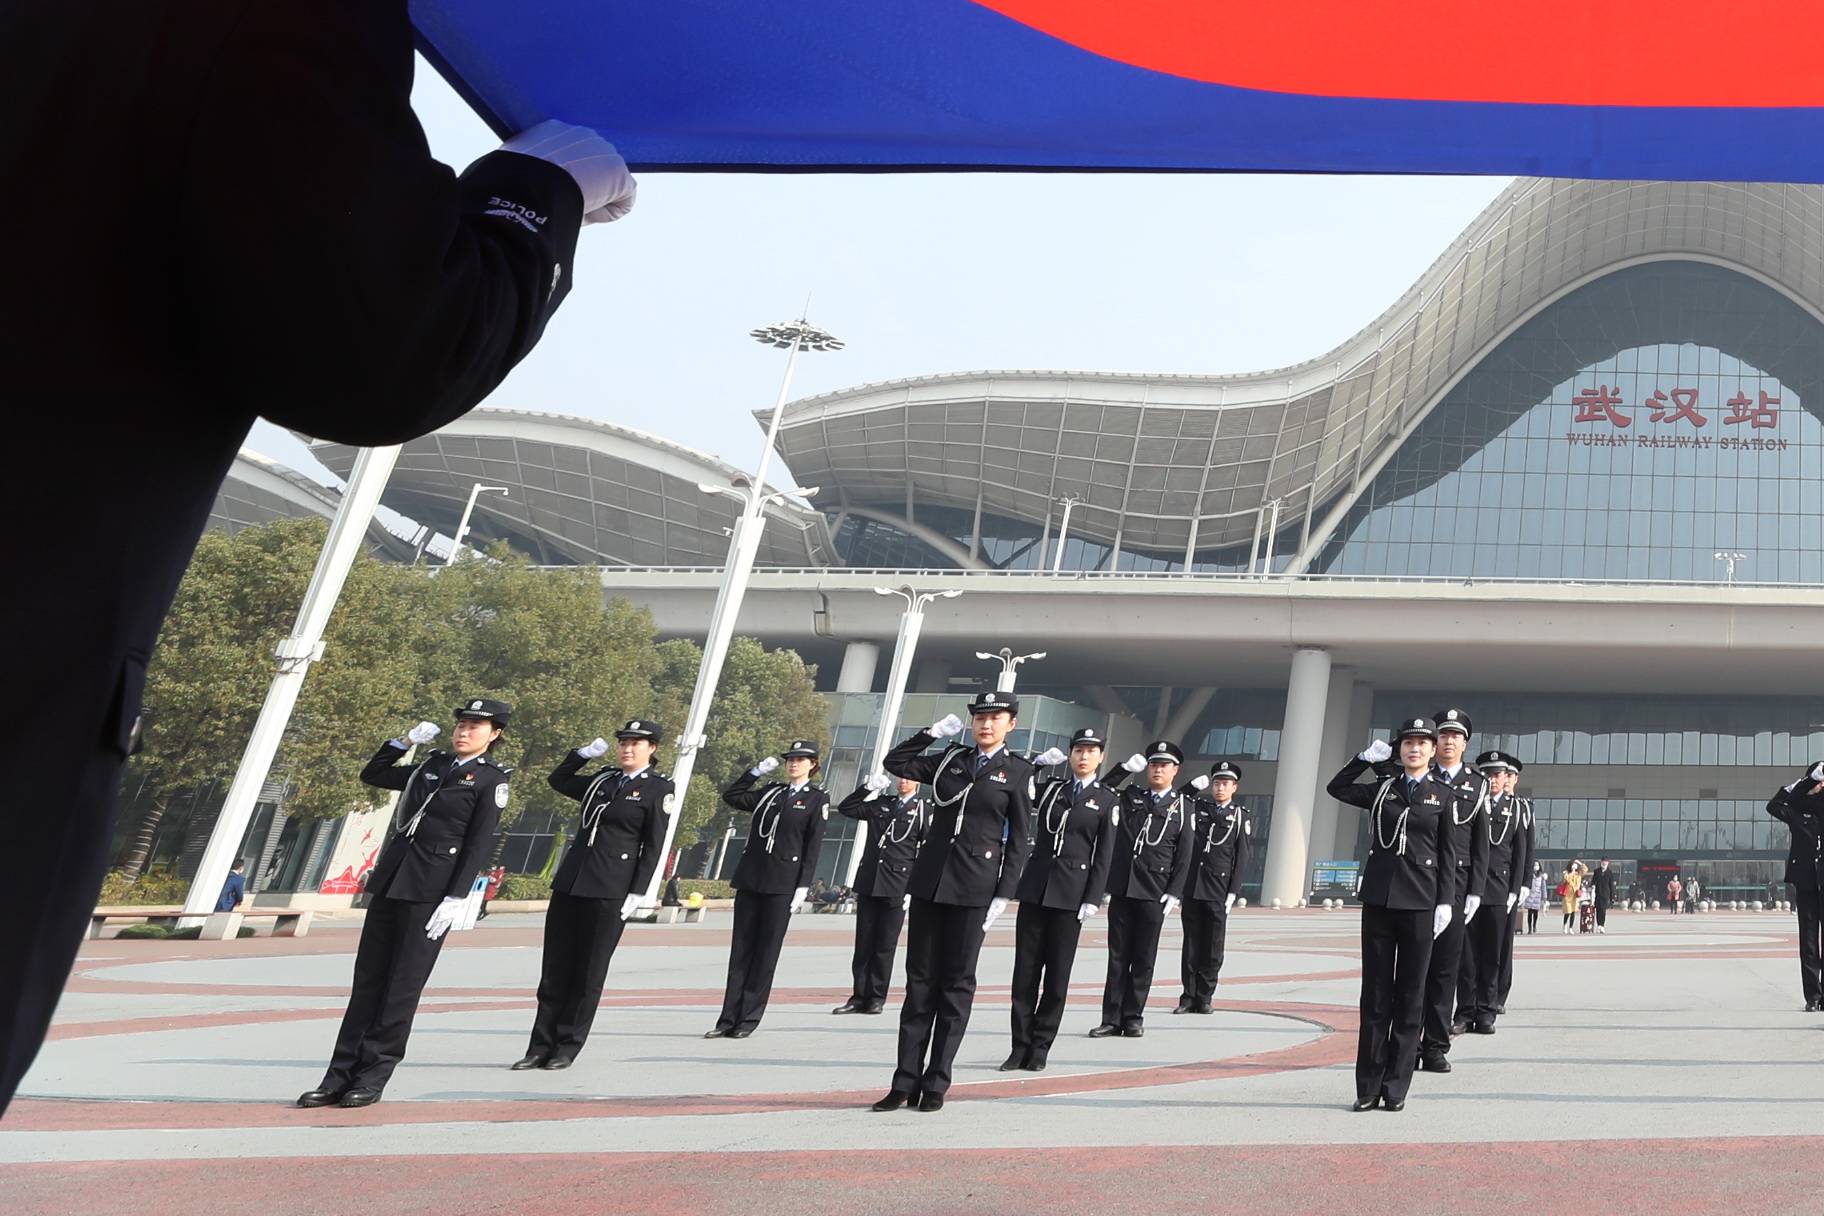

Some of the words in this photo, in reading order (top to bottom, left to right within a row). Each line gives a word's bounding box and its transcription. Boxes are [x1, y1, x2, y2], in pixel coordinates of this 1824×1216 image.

[488, 197, 548, 225] POLICE
[1572, 384, 1781, 429] 武汉站
[1566, 433, 1628, 447] WUHAN
[1638, 434, 1712, 449] RAILWAY
[1720, 437, 1788, 451] STATION
